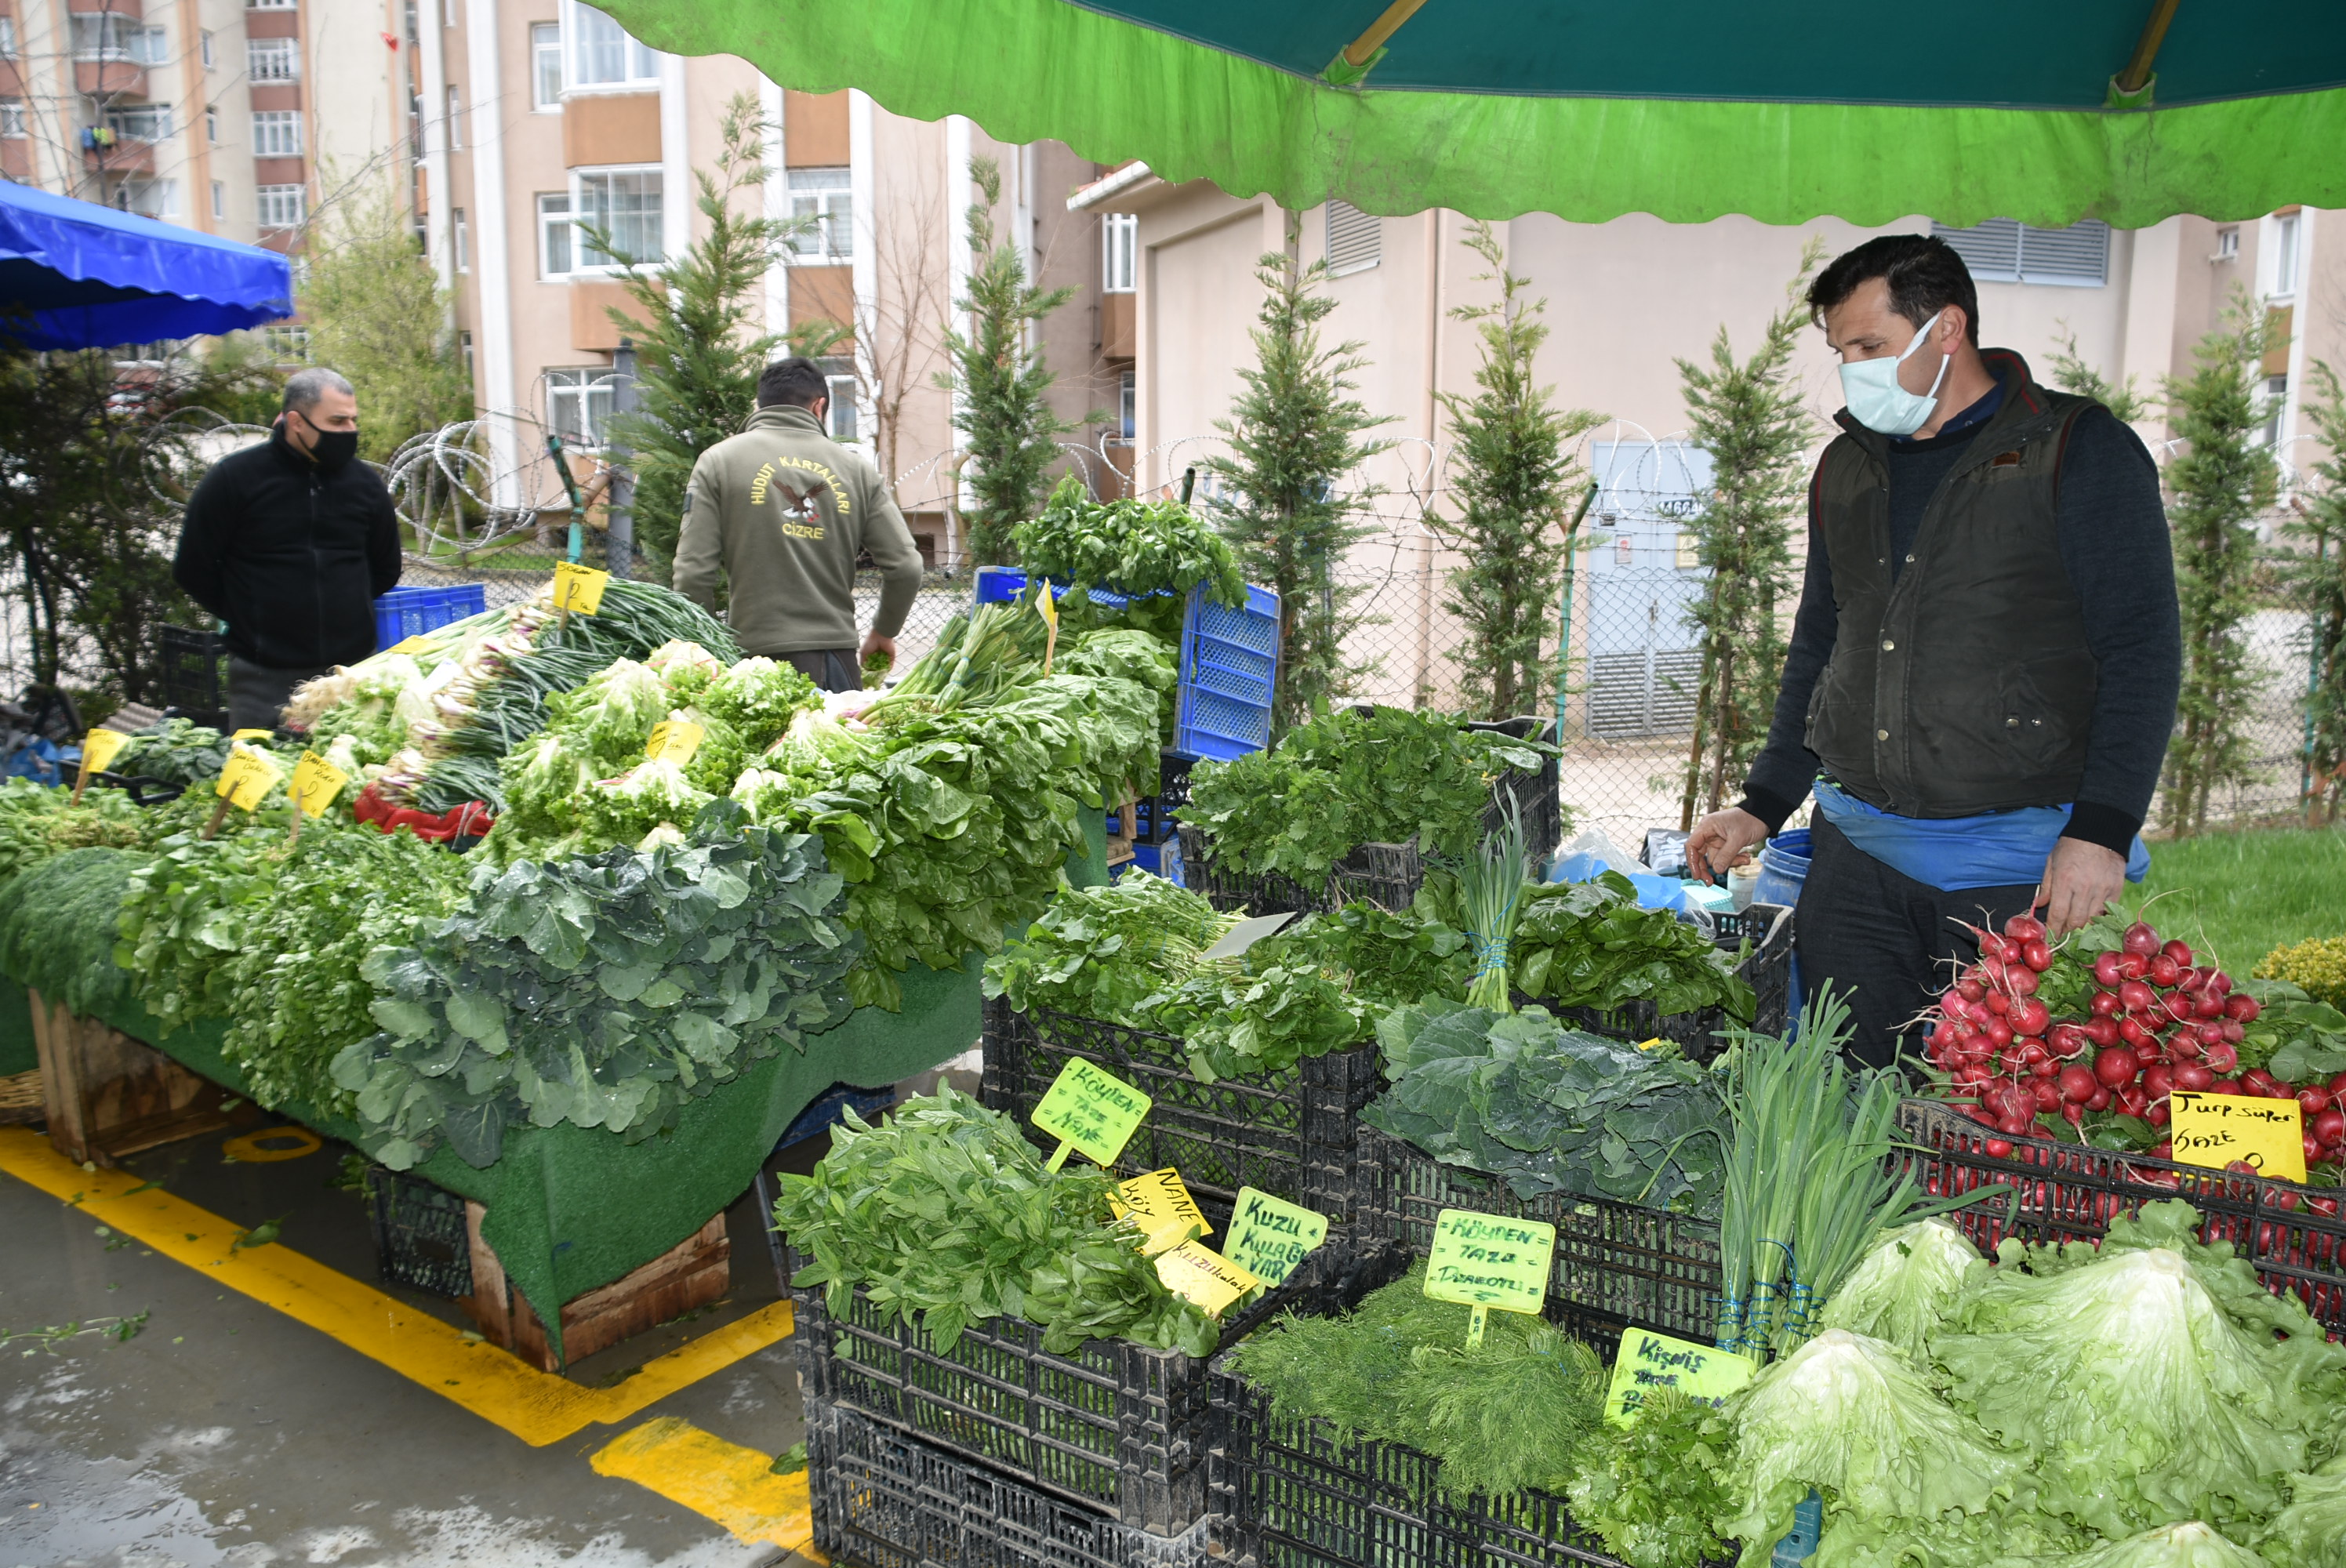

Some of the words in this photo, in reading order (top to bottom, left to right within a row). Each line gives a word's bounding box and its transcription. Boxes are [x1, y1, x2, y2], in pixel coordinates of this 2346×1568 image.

[750, 463, 776, 505] HUDUT
[779, 456, 851, 514] KARTALLARI
[782, 521, 825, 539] CİZRE
[568, 583, 580, 599] 2
[1157, 1171, 1200, 1223] NANE
[1450, 1218, 1537, 1244] KÖYDEN
[1249, 1256, 1286, 1284] VAR
